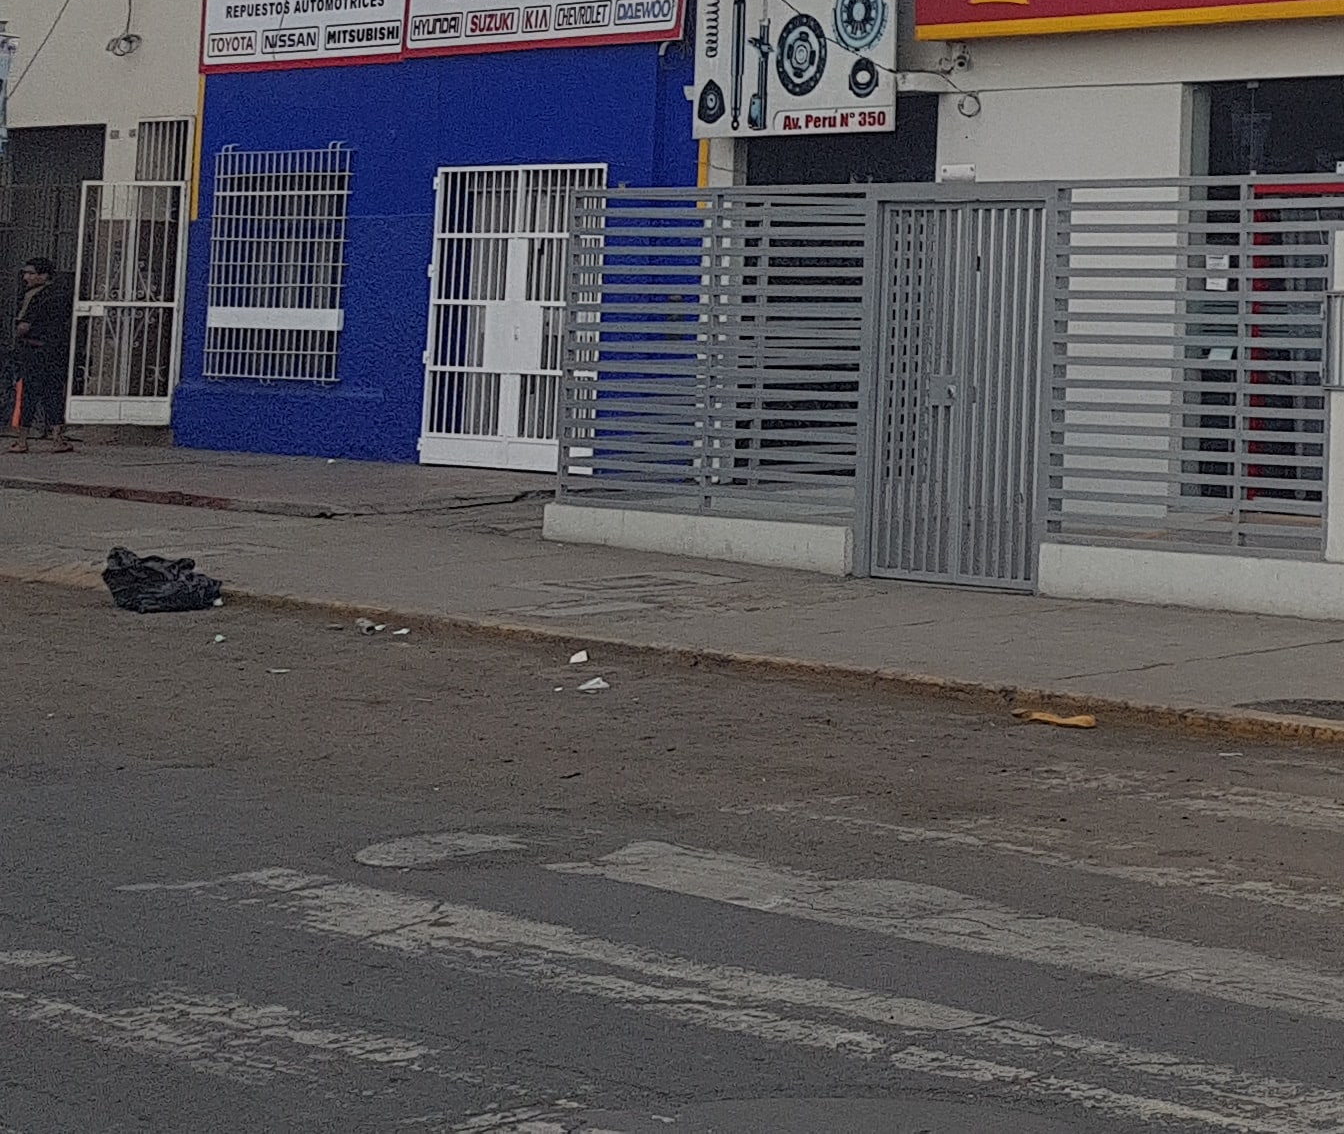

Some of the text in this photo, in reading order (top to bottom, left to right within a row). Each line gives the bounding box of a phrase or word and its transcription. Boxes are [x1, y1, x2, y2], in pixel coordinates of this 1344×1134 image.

[226, 1, 290, 19] REPUESTOS
[557, 3, 609, 27] CHEVROLET
[413, 18, 460, 36] HYUNDAI
[470, 12, 515, 33] SUZUKI
[525, 10, 549, 30] KIA
[264, 32, 317, 49] NISSAN
[327, 26, 399, 44] MITSUBISHI
[210, 36, 254, 53] TOYOTA
[783, 115, 802, 130] Av.
[858, 111, 886, 127] 350
